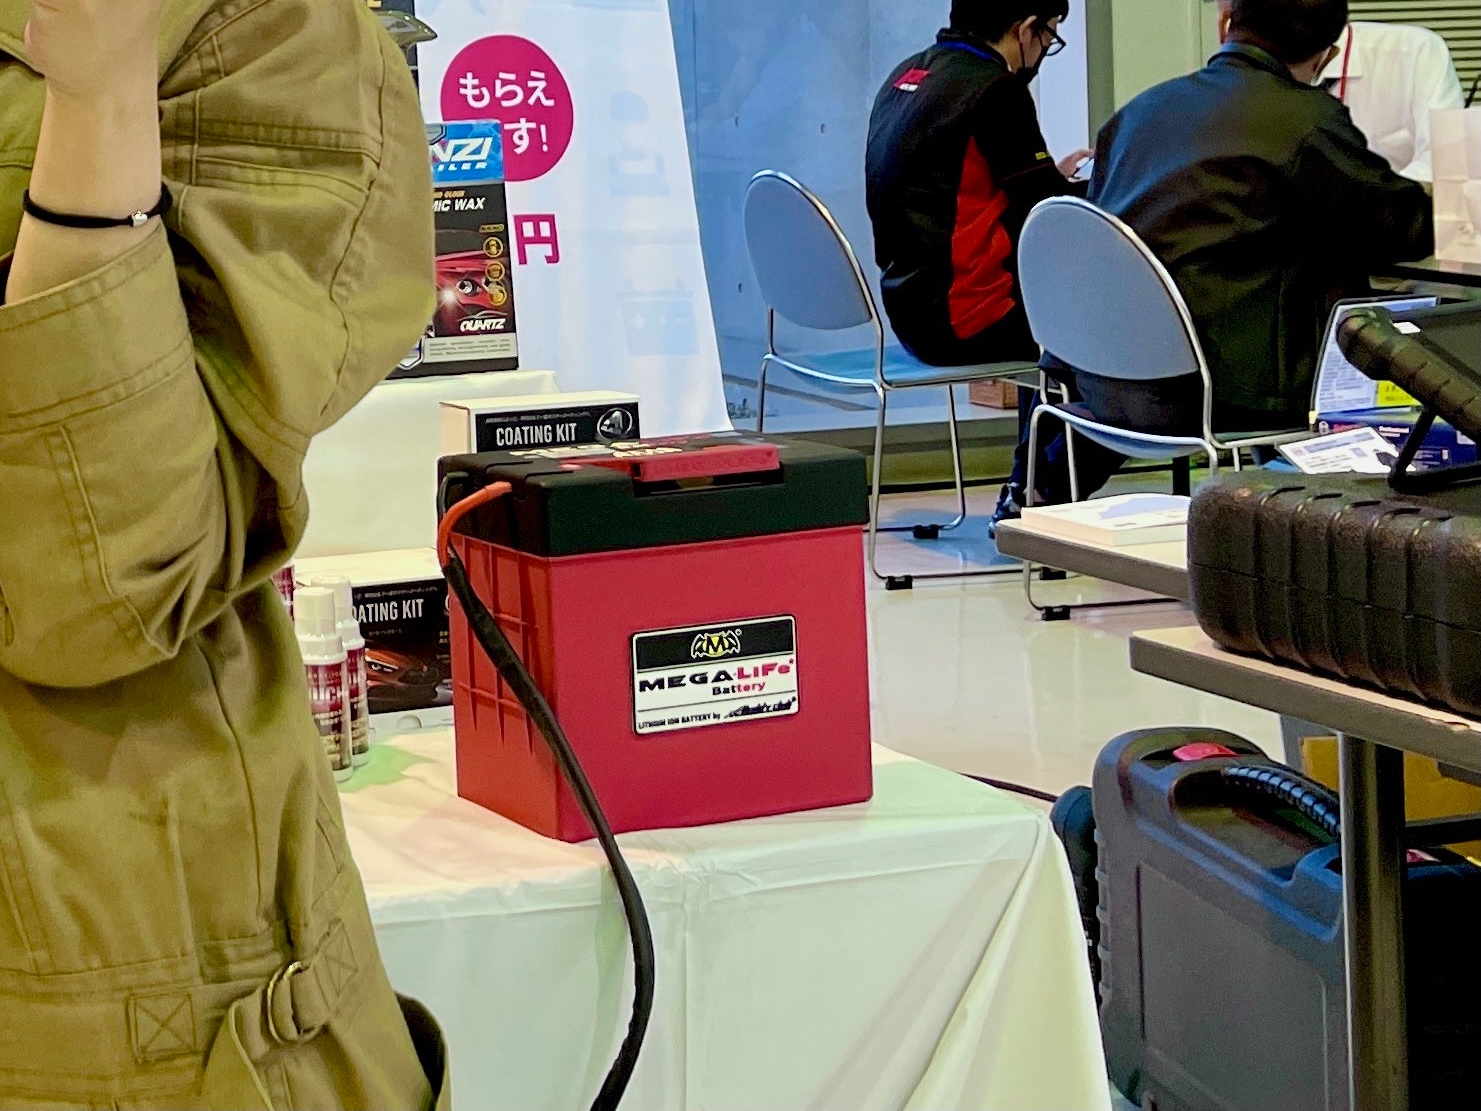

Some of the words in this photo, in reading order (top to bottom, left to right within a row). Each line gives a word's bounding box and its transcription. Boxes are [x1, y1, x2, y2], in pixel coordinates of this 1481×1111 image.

[459, 72, 555, 108] もらえ
[431, 162, 488, 172] ILER
[454, 197, 486, 211] WAX
[513, 213, 560, 265] 円
[496, 425, 553, 447] COATING
[556, 423, 577, 443] KIT
[402, 598, 424, 619] KIT
[712, 681, 766, 696] Battery
